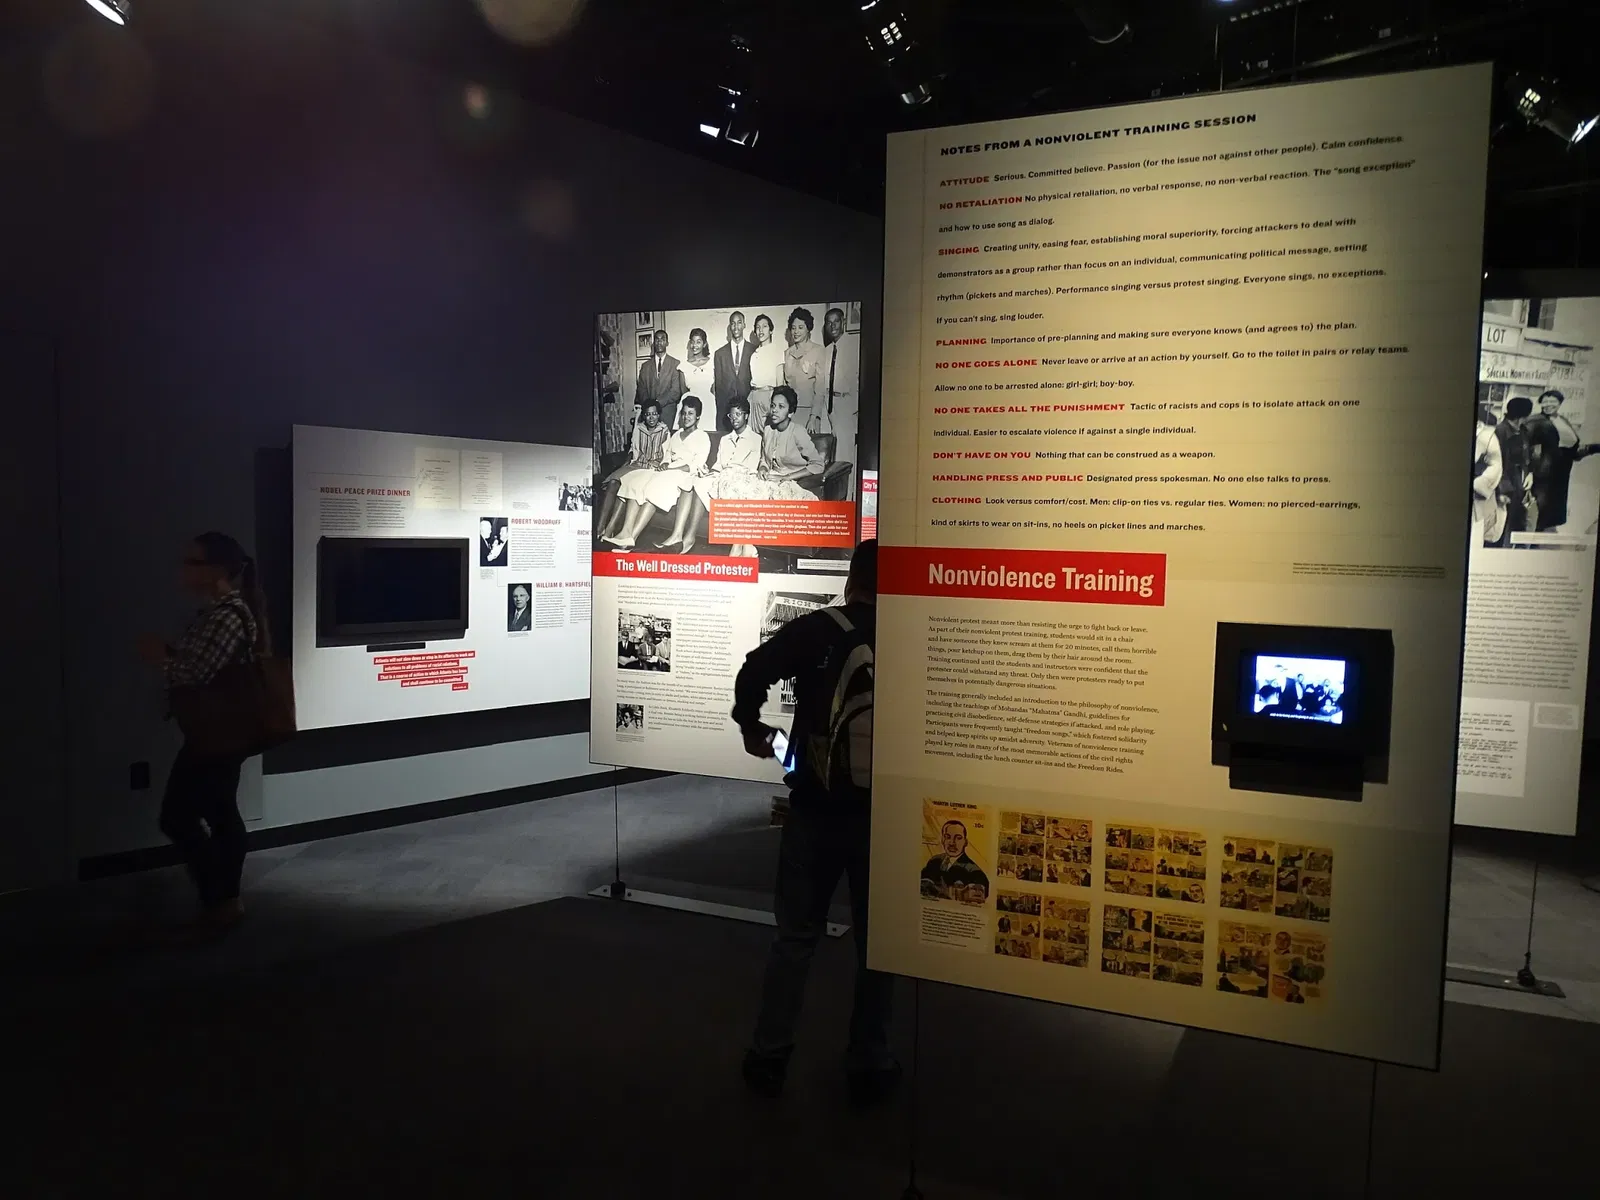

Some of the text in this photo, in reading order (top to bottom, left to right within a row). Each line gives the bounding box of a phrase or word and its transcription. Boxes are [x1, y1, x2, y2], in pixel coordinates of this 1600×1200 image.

[940, 113, 1256, 157] NOTES FROM A NONVIOLENT TRAINING SESSION
[939, 175, 990, 188] ATTITUDE
[993, 173, 1026, 182] Serious.
[1027, 166, 1072, 179] Committed
[1073, 165, 1106, 174] believe.
[1107, 161, 1140, 171] Passion
[1142, 158, 1159, 169] (for
[1160, 157, 1175, 166] the
[1177, 156, 1200, 164] issue
[1201, 153, 1217, 162] not
[1218, 149, 1252, 161] against
[1253, 147, 1279, 157] other
[1280, 141, 1319, 156] people).
[1320, 140, 1346, 150] Calm
[938, 217, 1055, 233] and how to use song as dialog.
[937, 217, 1356, 256] SINGING Creating unity, easing fear, establishing moral superiority, forcing attackers to deal with
[936, 311, 1044, 325] If you can't sing, sing louder.
[935, 321, 1357, 347] PLANNING Importance of pre-planning and making sure everyone knows (and agrees to) the plan.
[1487, 326, 1506, 344] LOT
[932, 451, 962, 459] DON'T
[964, 451, 992, 459] HAVE
[993, 451, 1008, 459] ON
[1009, 451, 1031, 459] YOU
[1034, 451, 1067, 460] Nothing
[1068, 451, 1085, 459] that
[1103, 450, 1114, 459] be
[1115, 450, 1158, 459] construed
[1178, 451, 1215, 459] weapon.
[343, 487, 365, 495] PEACE
[366, 488, 385, 496] PRIZE
[386, 489, 411, 497] DINNER
[616, 559, 753, 576] The Well Dressed Protester
[928, 563, 1155, 598] Nonviolence Training
[784, 598, 822, 609] RICH'S
[928, 615, 959, 623] Nonviolent
[1016, 619, 1030, 627] than
[1031, 621, 1056, 629] resisting
[1090, 623, 1105, 632] fight
[1106, 624, 1121, 632] back
[1130, 625, 1148, 633] leave.
[780, 693, 796, 704] MUS
[924, 749, 955, 757] movement,
[955, 751, 983, 761] including
[983, 753, 993, 761] the
[993, 754, 1010, 762] lunch
[1010, 757, 1034, 765] counter
[1066, 761, 1077, 769] the
[1077, 763, 1104, 772] Freedom
[1105, 765, 1124, 773] Rides.
